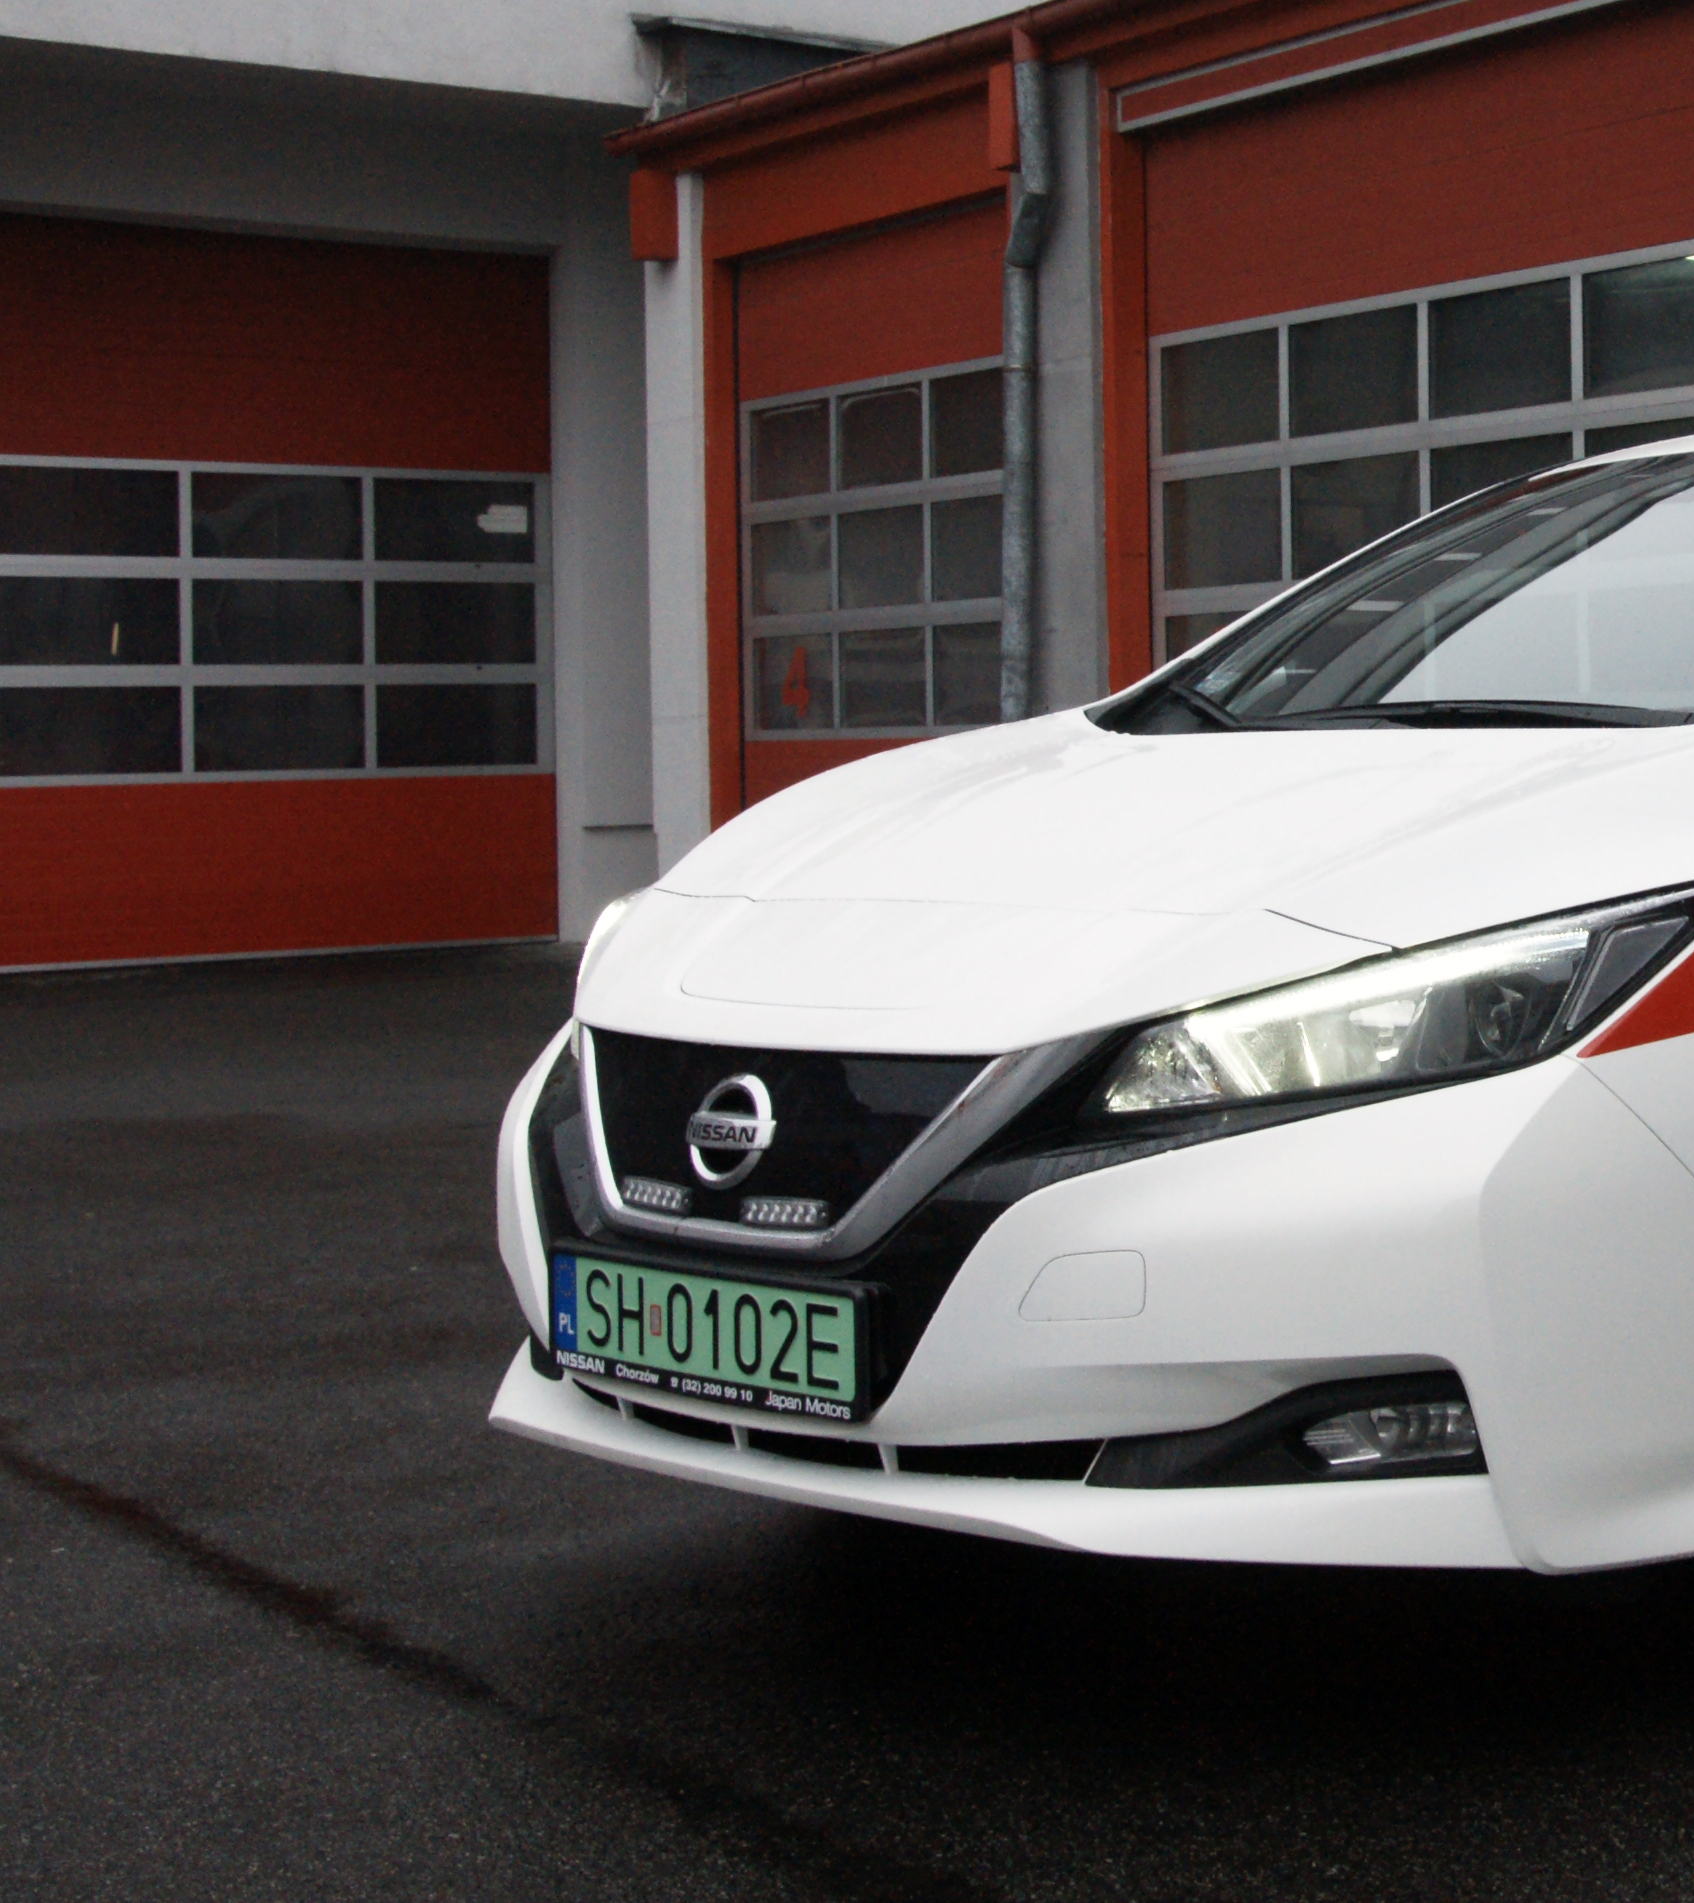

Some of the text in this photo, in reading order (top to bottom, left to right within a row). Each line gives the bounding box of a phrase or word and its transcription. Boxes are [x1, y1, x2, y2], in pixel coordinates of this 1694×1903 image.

[782, 647, 810, 717] 4
[688, 1120, 756, 1143] NISSAN
[558, 1312, 575, 1335] PL
[586, 1268, 840, 1391] SH 0102E
[556, 1350, 851, 1420] NISSAN Chorzów (32) 200 99 10 Japan Motors
